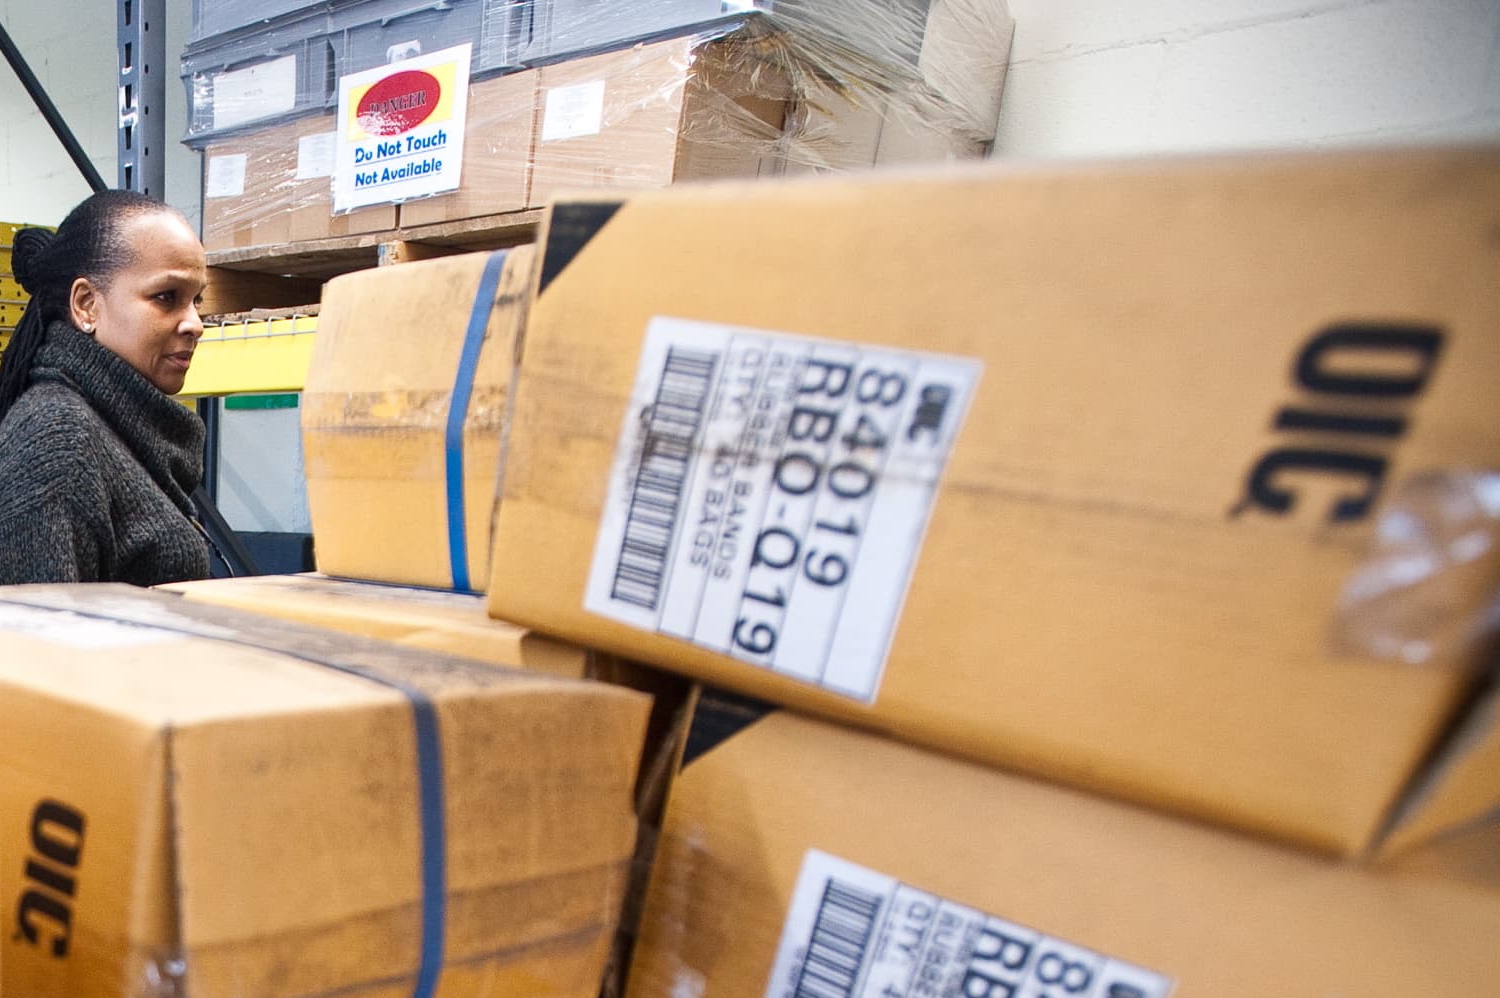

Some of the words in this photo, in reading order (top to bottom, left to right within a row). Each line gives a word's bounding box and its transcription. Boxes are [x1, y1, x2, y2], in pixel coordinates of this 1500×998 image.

[369, 89, 426, 117] DANGER
[355, 147, 373, 163] Do
[377, 141, 402, 158] Not
[406, 129, 447, 152] Touch
[355, 171, 378, 187] Not
[381, 158, 442, 182] Available
[802, 366, 907, 588] 84019
[733, 358, 853, 655] RBO-Q19
